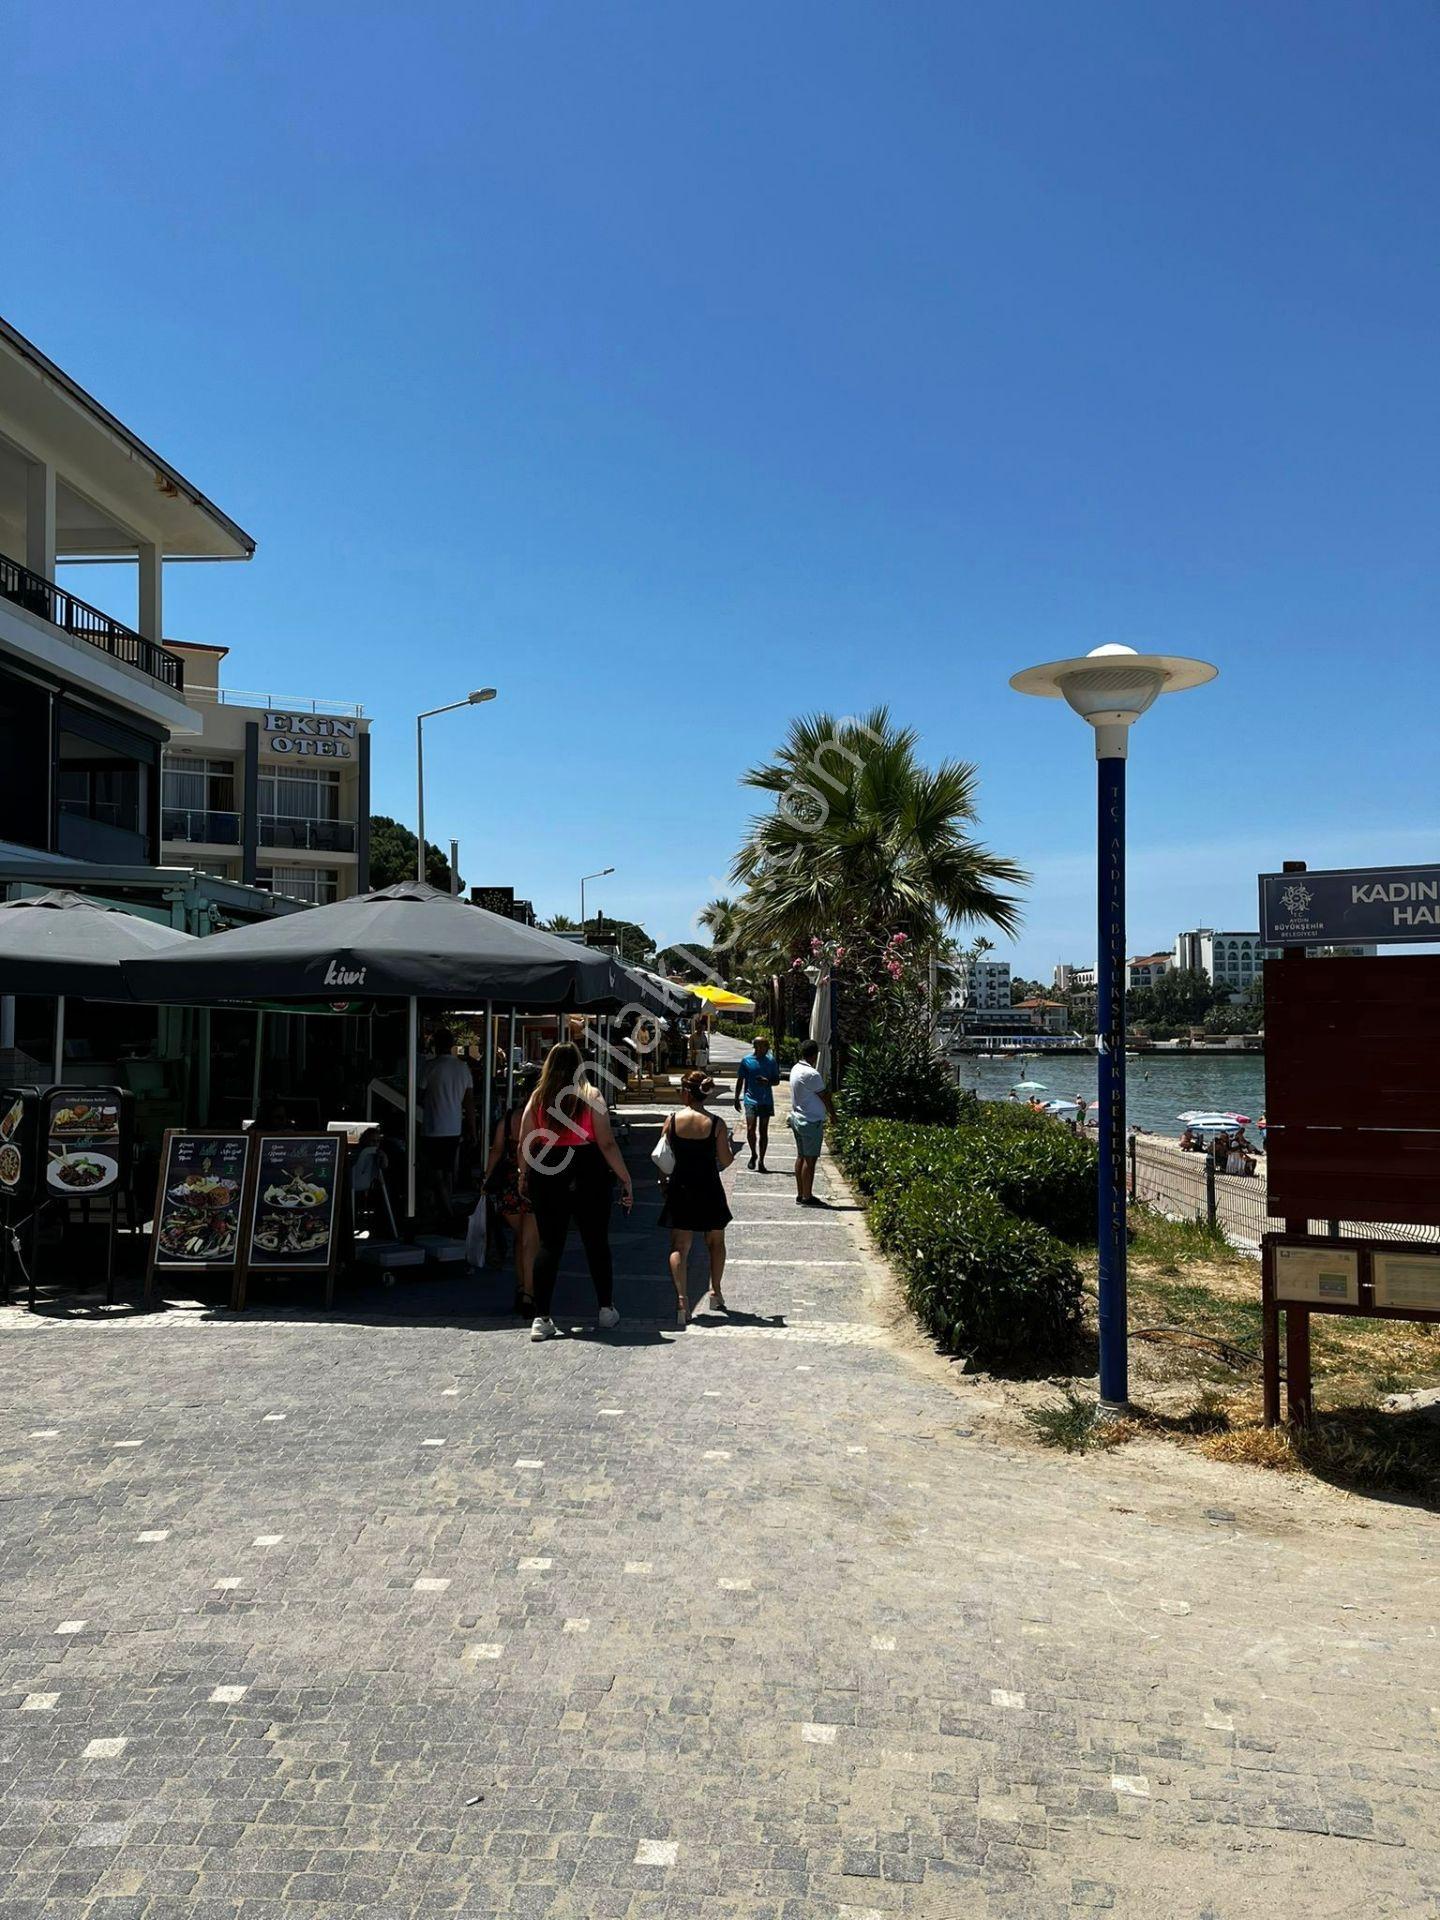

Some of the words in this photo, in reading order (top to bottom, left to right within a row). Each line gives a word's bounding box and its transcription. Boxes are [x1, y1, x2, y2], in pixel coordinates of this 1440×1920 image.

[271, 736, 351, 758] OTEL
[1351, 880, 1440, 904] KADIN
[323, 959, 368, 985] kiwi
